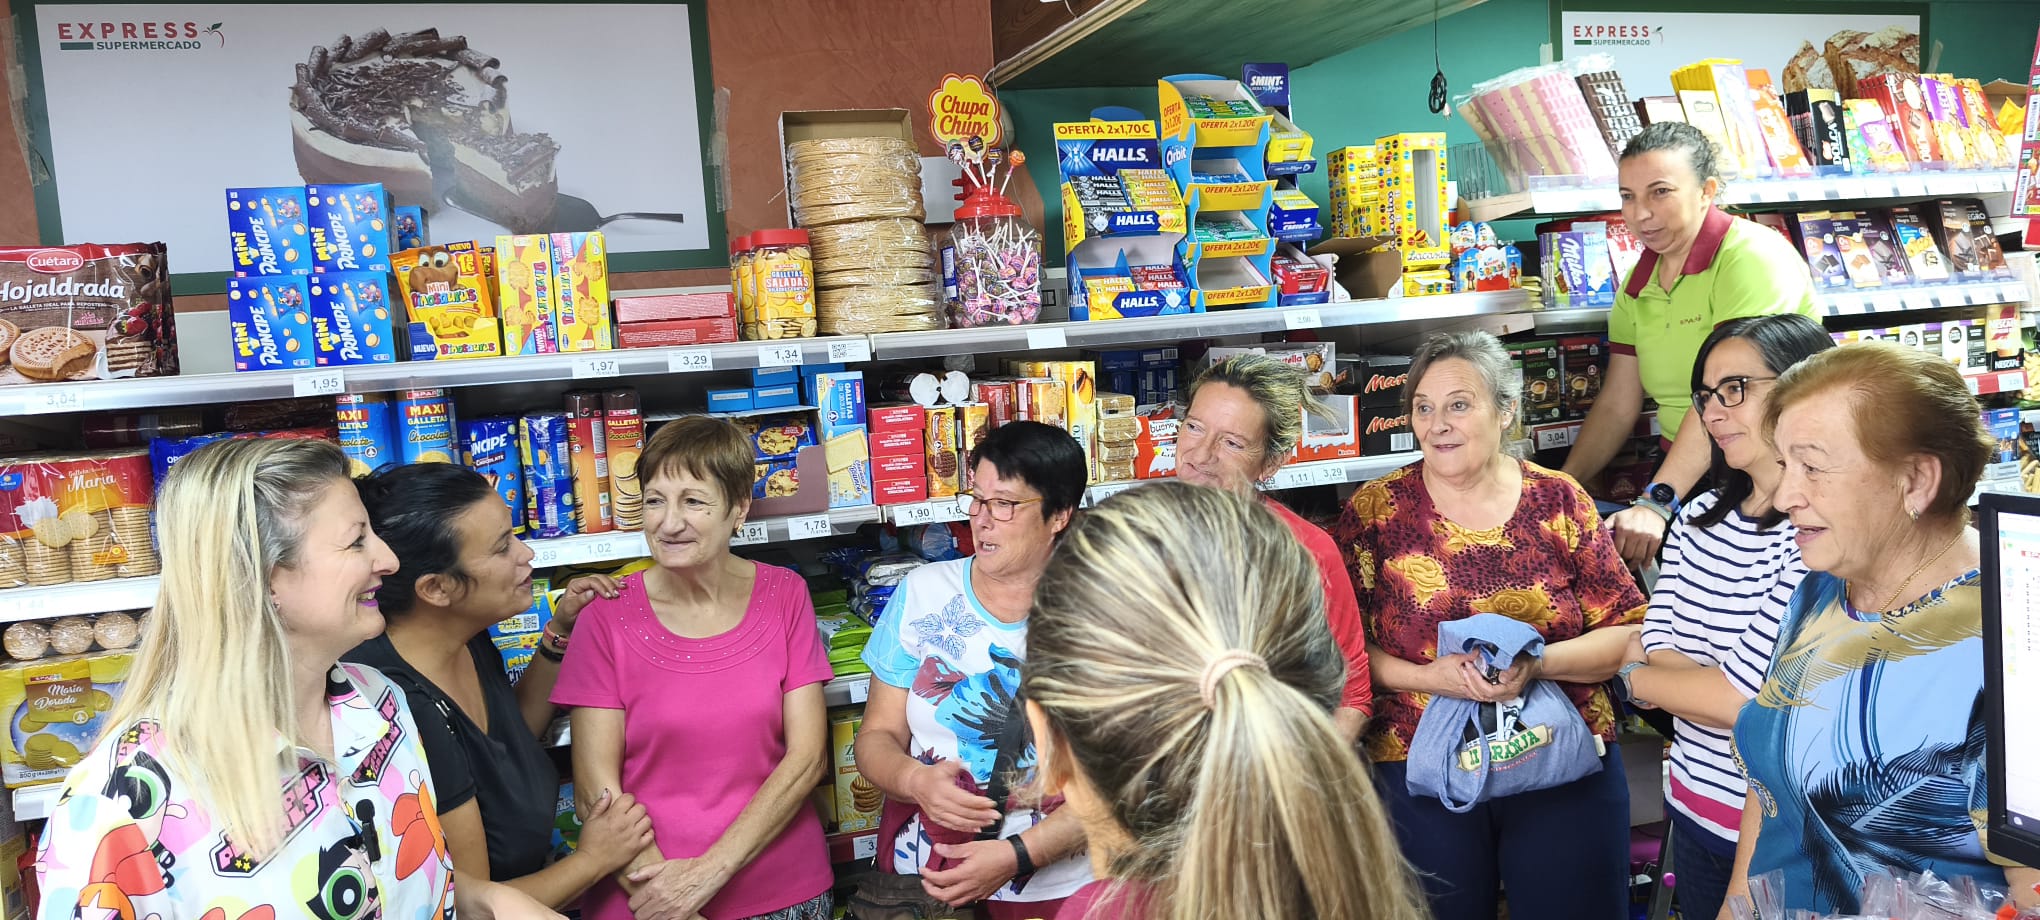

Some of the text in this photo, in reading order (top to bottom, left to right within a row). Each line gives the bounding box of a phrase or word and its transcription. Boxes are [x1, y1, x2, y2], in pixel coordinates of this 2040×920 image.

[58, 22, 198, 39] EXPRESS
[1573, 26, 1649, 37] EXPRESS
[97, 41, 201, 50] SUPERMERCADO
[1250, 75, 1282, 86] SMINT
[941, 95, 990, 117] Chupa
[939, 115, 989, 138] Chups
[1057, 123, 1151, 136] OFERTA 2x1,70€
[1201, 121, 1229, 129] OFERTA
[1092, 148, 1147, 161] HALLS
[1166, 145, 1187, 165] Orbit
[1204, 186, 1233, 194] OFERTA
[1115, 214, 1154, 226] HALLS
[249, 216, 282, 275] PRINCIPE
[328, 212, 360, 270] PRINCIPE
[1204, 244, 1232, 252] OFERTA
[29, 256, 80, 266] Cuétara
[1561, 237, 1586, 288] Milka
[766, 278, 809, 287] SALADAS
[1148, 273, 1175, 281] HALLS
[1207, 292, 1235, 300] OFERTA
[1120, 297, 1156, 309] HALLS
[250, 306, 283, 366] PRINCIPE
[330, 302, 363, 361] PRINCIPE
[414, 344, 436, 353] NUEVO
[775, 349, 798, 360] 1,34
[682, 355, 708, 366] 3,29
[589, 361, 615, 372] 1,97
[311, 378, 338, 390] 1,95
[1365, 372, 1409, 394] Mars
[845, 382, 854, 419] GALLETAS
[410, 403, 445, 416] MAXI
[407, 415, 447, 425] GALLETAS
[1365, 415, 1410, 436] Mars
[338, 422, 369, 430] LLETAS
[1150, 422, 1175, 434] bueno
[1547, 432, 1565, 443] 3,04
[1290, 473, 1308, 483] 1,11
[1323, 468, 1342, 478] 3,29
[908, 508, 930, 518] 1,90
[804, 520, 827, 531] 1,78
[740, 527, 762, 538] 1,91
[34, 696, 78, 710] Dorada
